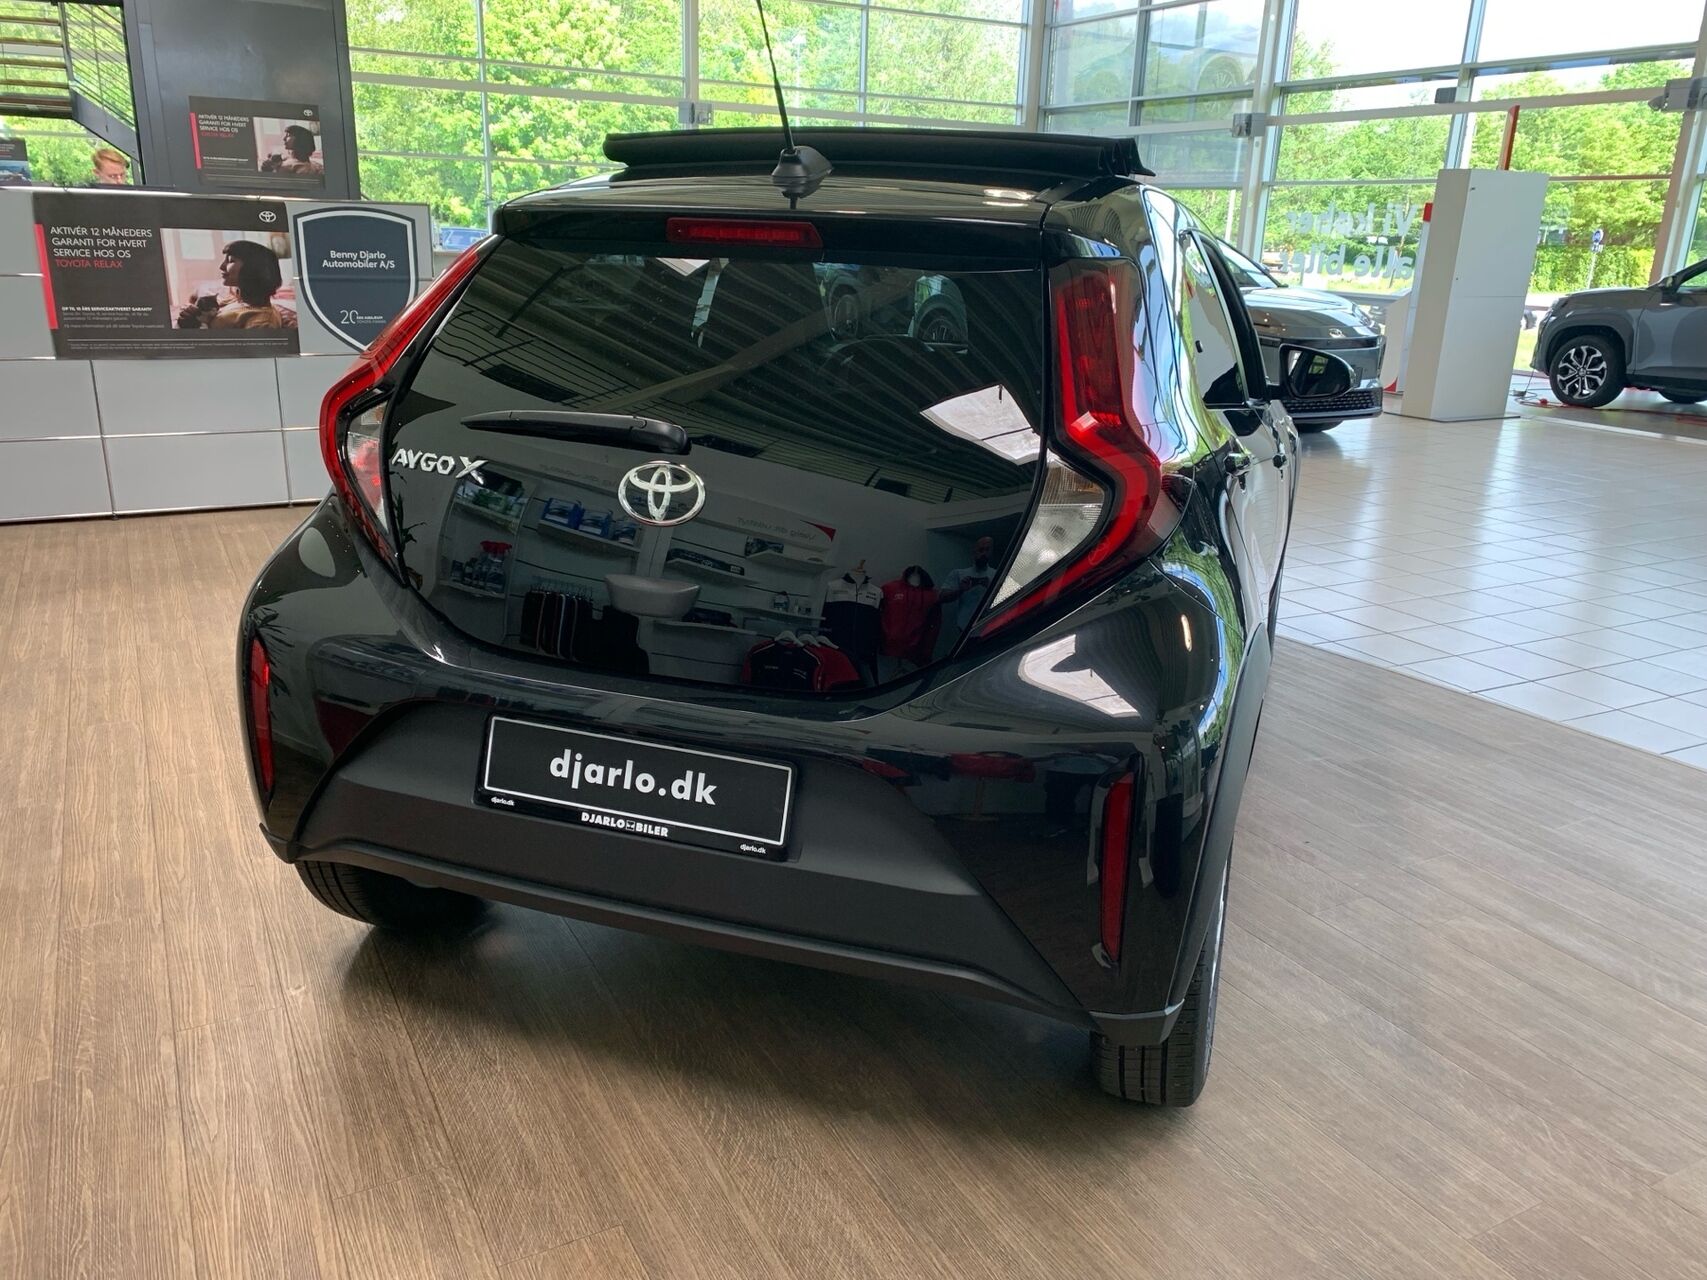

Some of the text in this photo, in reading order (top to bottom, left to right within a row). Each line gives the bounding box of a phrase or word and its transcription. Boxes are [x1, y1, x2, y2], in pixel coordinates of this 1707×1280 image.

[50, 225, 153, 237] AKTIVÉR 12 MÅNEDERS
[51, 237, 147, 248] GARANTI FOR HVERT
[53, 248, 131, 258] SERVICE HOS OS
[330, 250, 386, 262] Benny Djarlo
[55, 259, 123, 268] TOYOTA RELAX
[322, 260, 396, 270] Automobiler A/S
[340, 309, 359, 324] 20
[391, 448, 488, 485] AYGO X
[550, 748, 718, 806] djarlo.dk
[490, 796, 515, 807] djarlo.dk
[581, 811, 669, 837] DJARLO BILER
[739, 843, 766, 855] djarlo.dk
